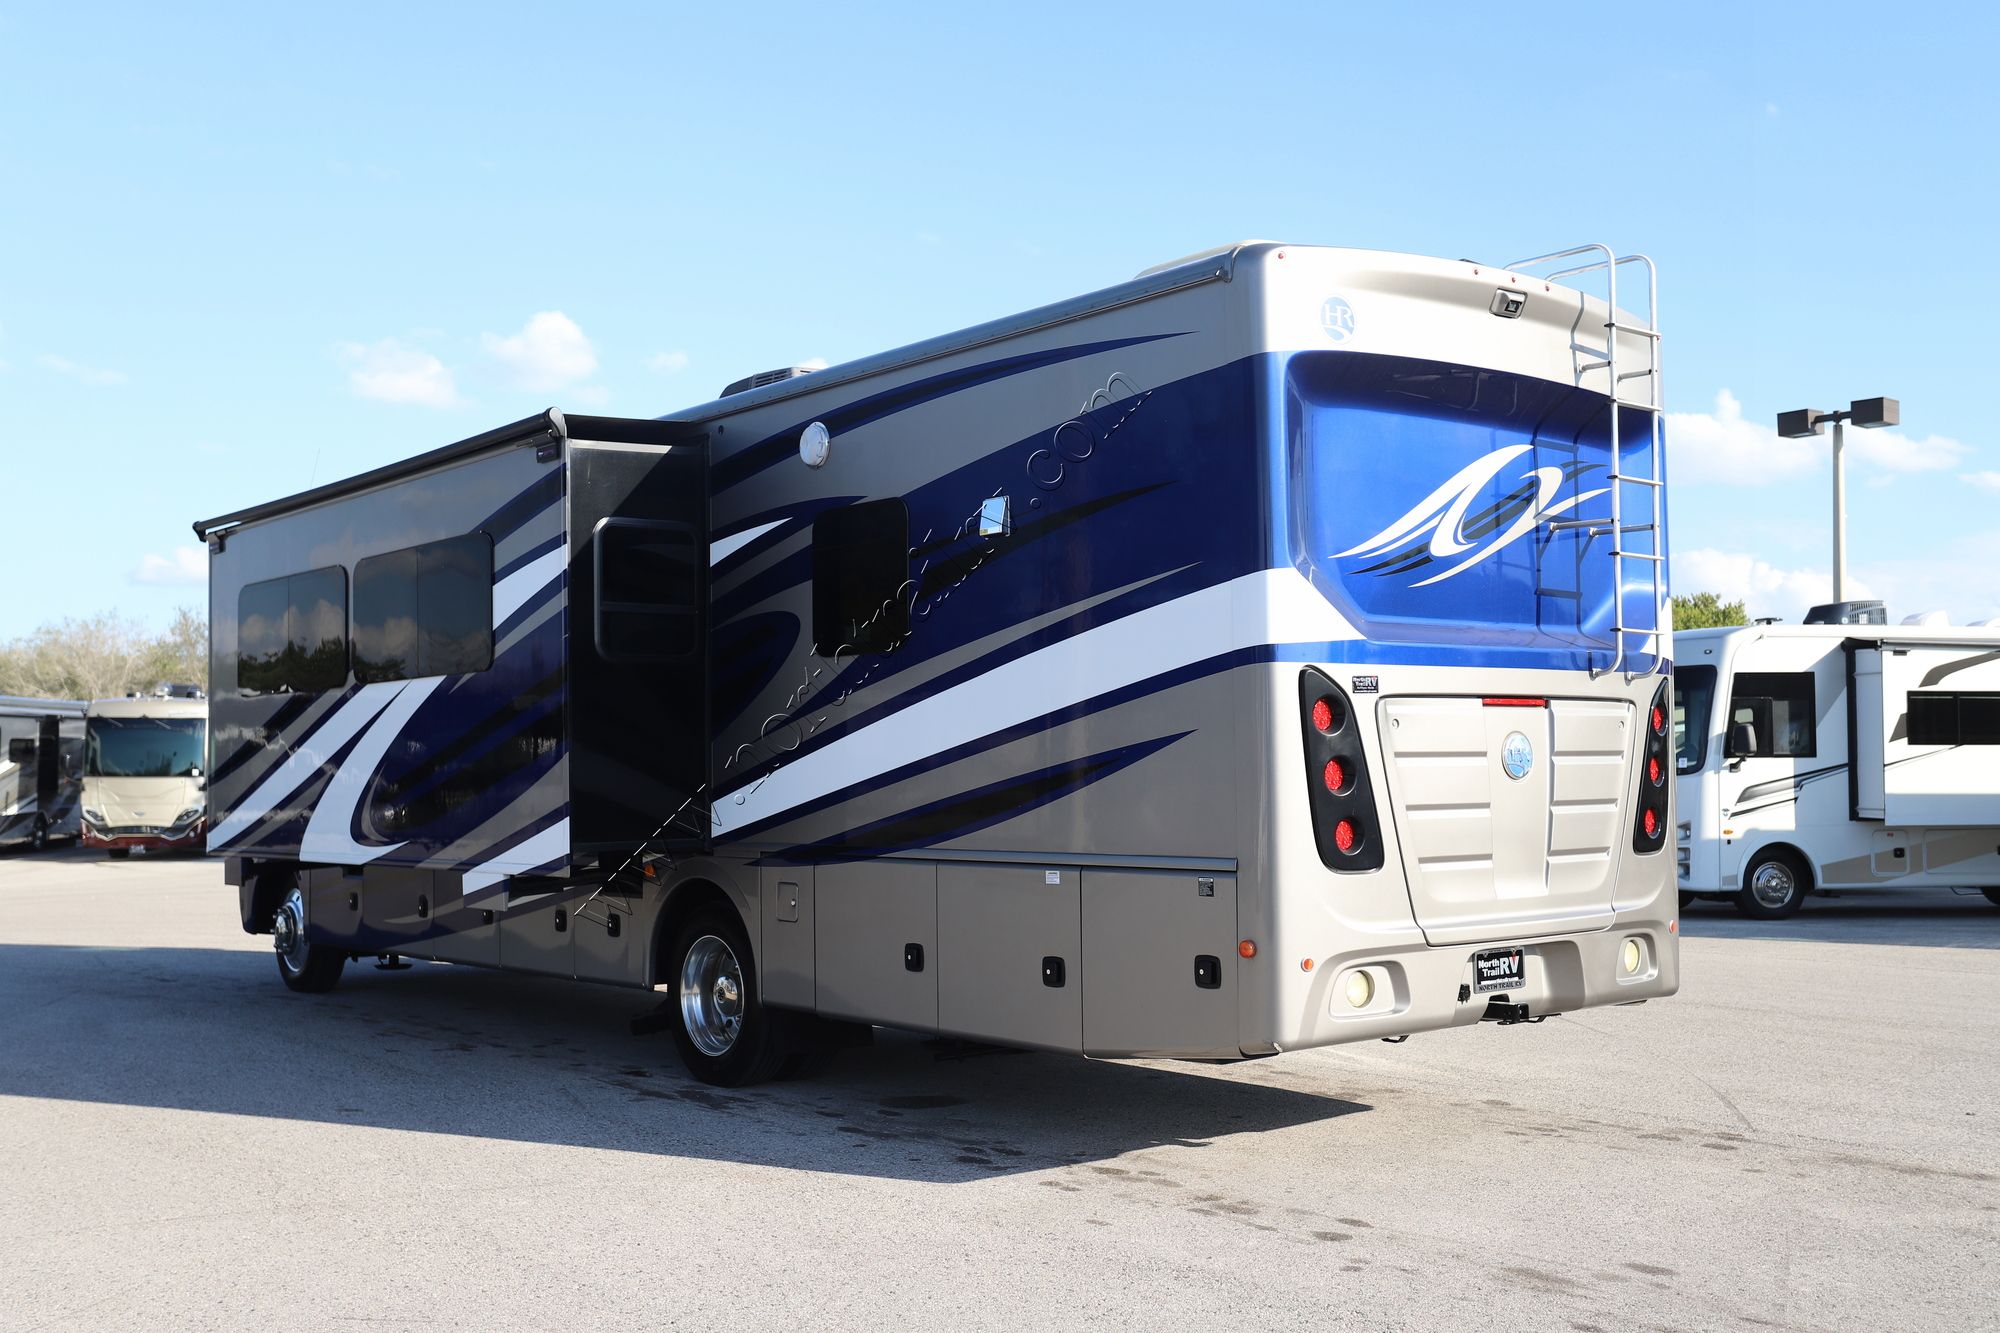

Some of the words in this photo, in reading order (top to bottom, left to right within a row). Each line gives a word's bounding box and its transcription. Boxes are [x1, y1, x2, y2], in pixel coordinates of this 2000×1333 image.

[1324, 303, 1355, 328] HR
[1365, 676, 1378, 687] RV
[1478, 958, 1499, 969] North
[1499, 955, 1520, 975] RV
[1482, 967, 1500, 977] Trail
[1478, 984, 1498, 992] NORTH
[1498, 981, 1514, 989] TRAIL
